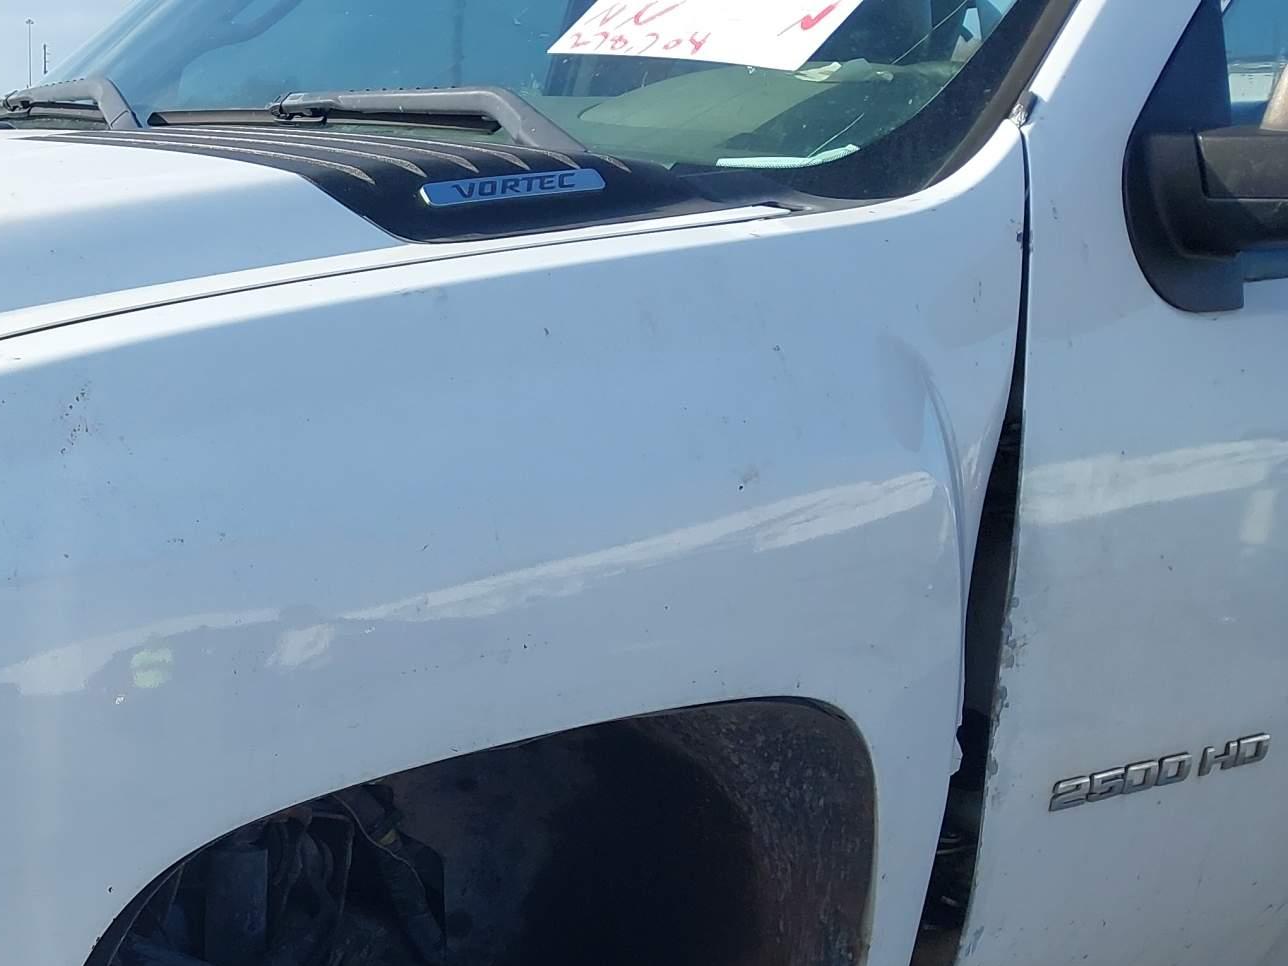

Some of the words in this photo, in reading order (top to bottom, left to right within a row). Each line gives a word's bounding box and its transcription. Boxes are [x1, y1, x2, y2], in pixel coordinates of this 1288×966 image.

[452, 173, 575, 198] VORTEC
[1048, 751, 1192, 812] 2500
[1198, 732, 1271, 777] HD
